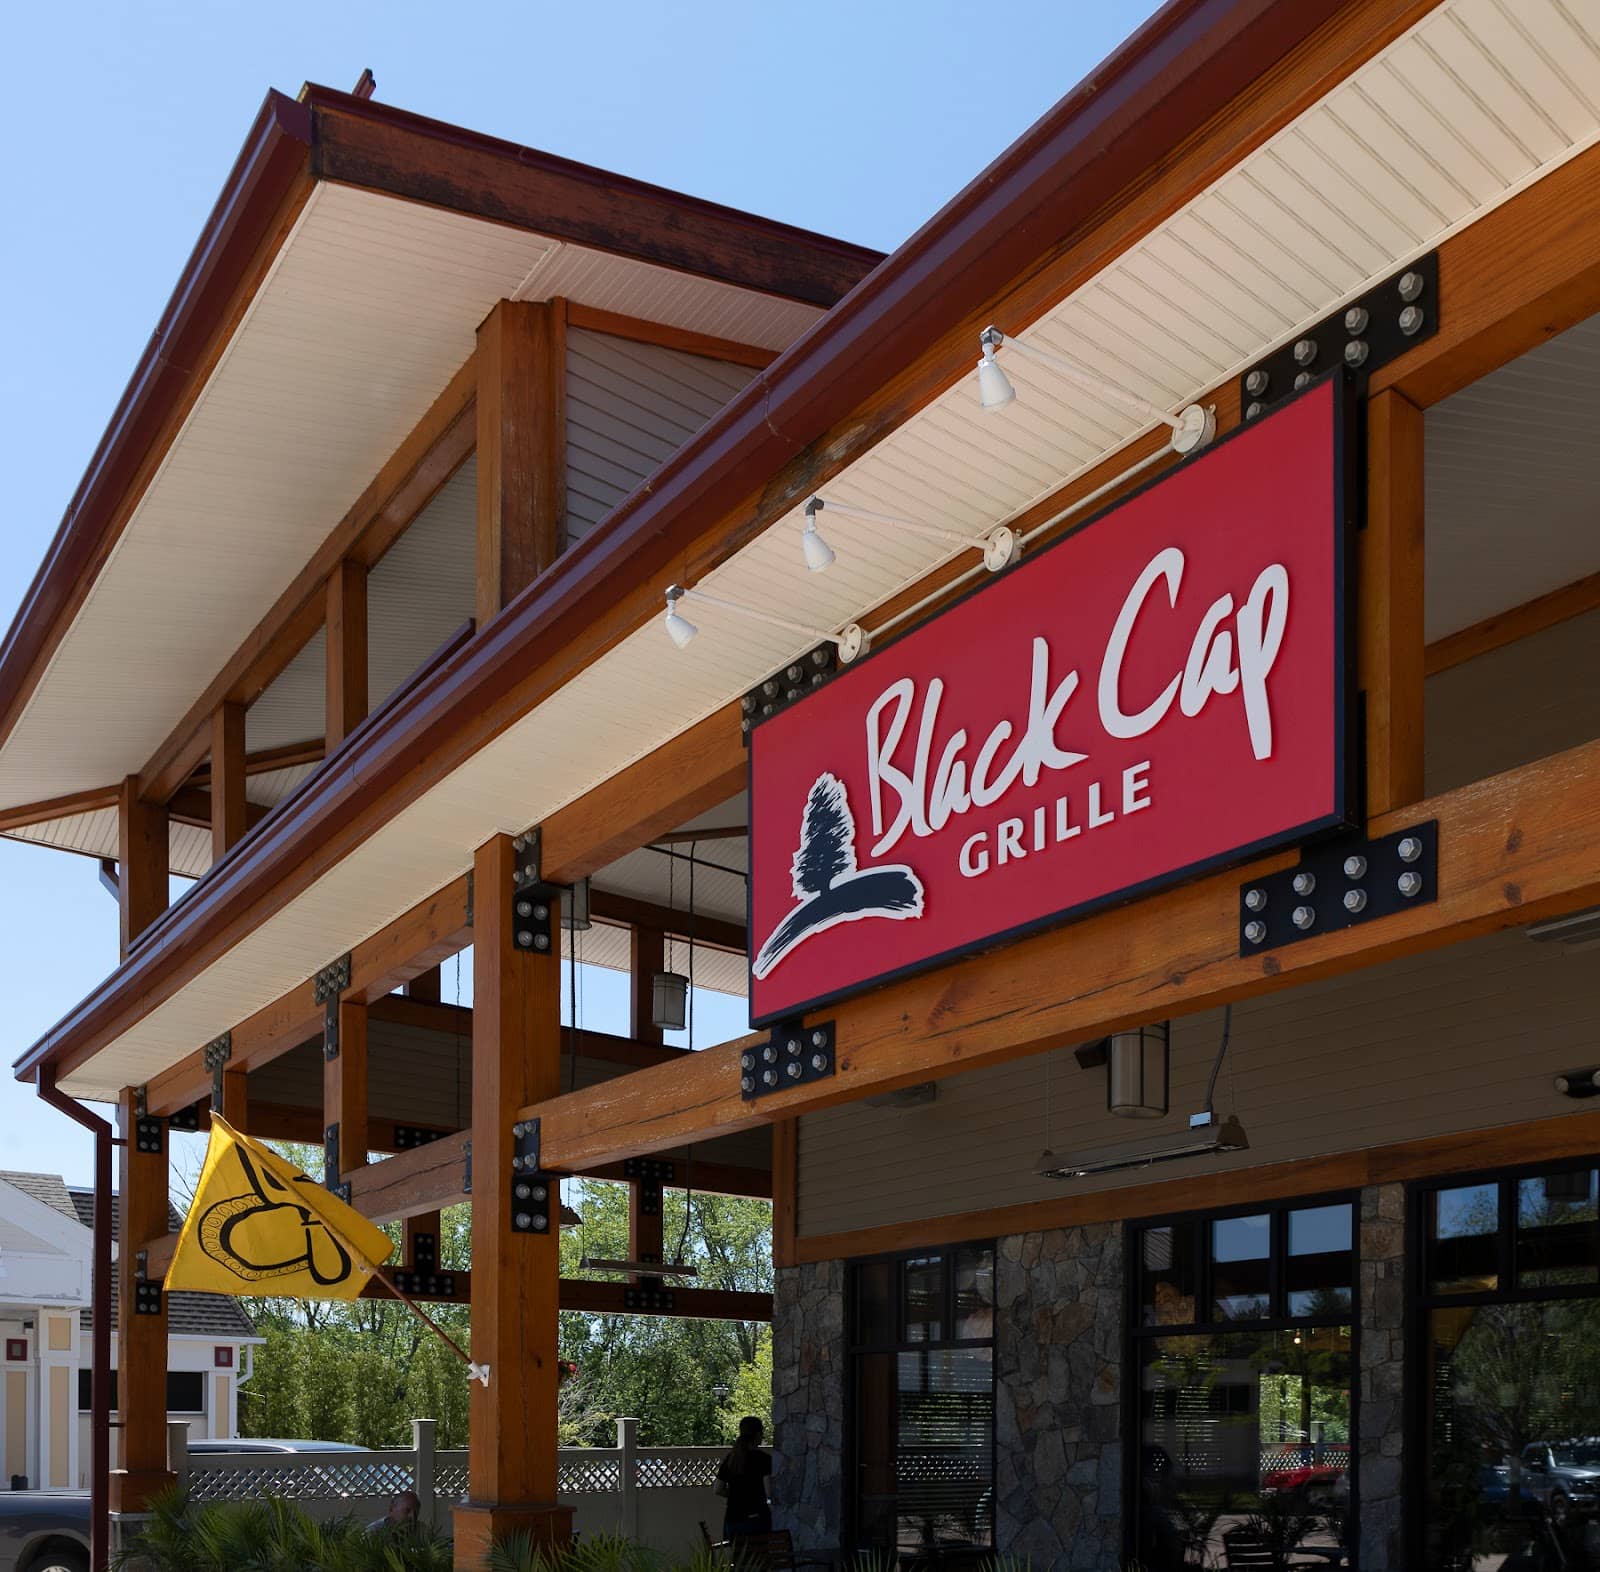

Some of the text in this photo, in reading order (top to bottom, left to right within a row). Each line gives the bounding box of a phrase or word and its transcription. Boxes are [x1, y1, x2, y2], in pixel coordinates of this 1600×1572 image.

[865, 547, 1289, 857] Black Cap
[958, 760, 1152, 878] GRILLE
